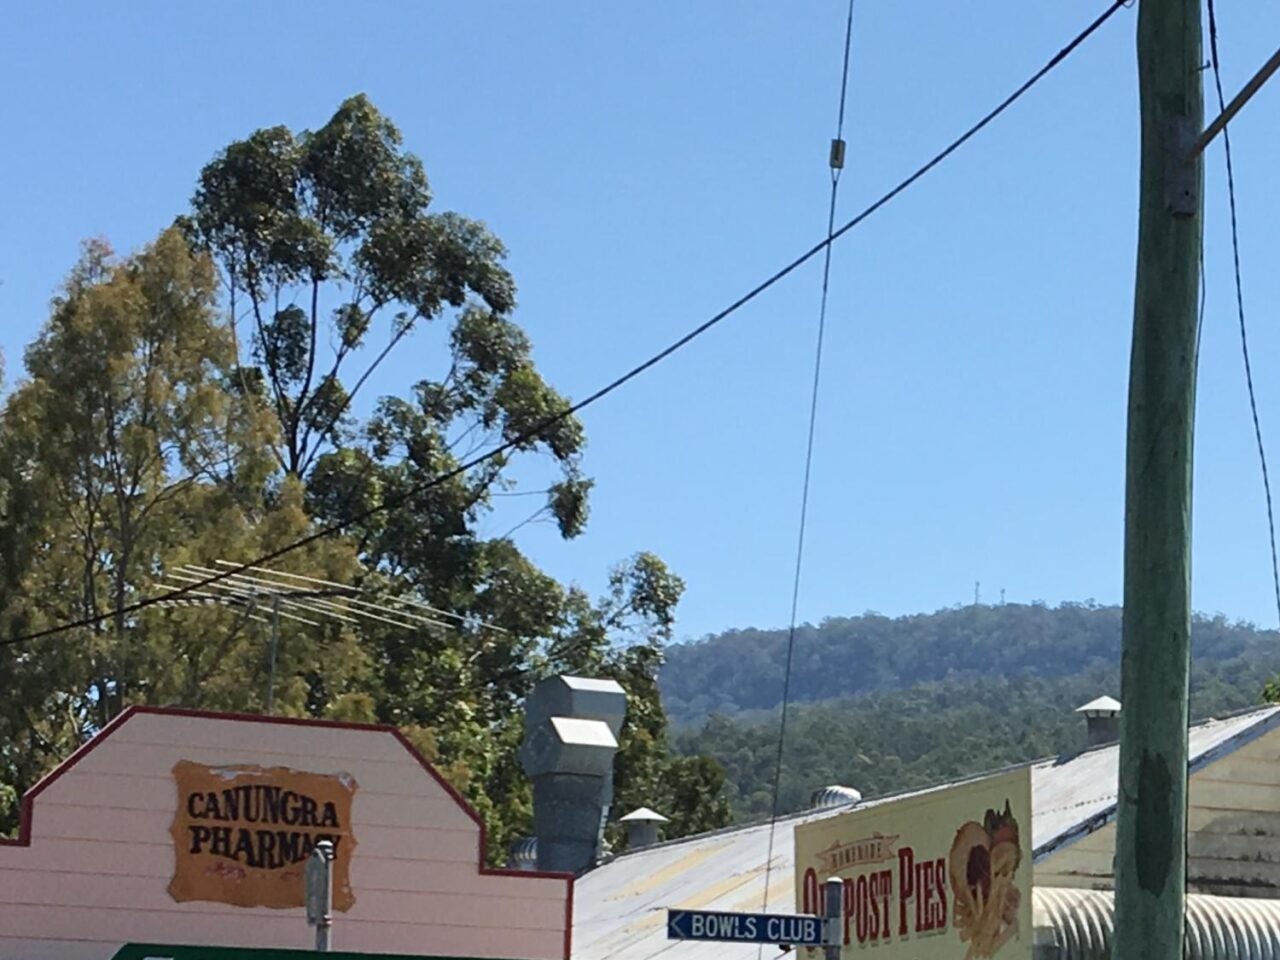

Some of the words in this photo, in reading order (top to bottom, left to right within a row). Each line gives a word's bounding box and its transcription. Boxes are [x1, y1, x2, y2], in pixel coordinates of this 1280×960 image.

[188, 785, 340, 828] CANUNGRA
[691, 914, 757, 938] BOWLS
[767, 918, 816, 941] CLUB
